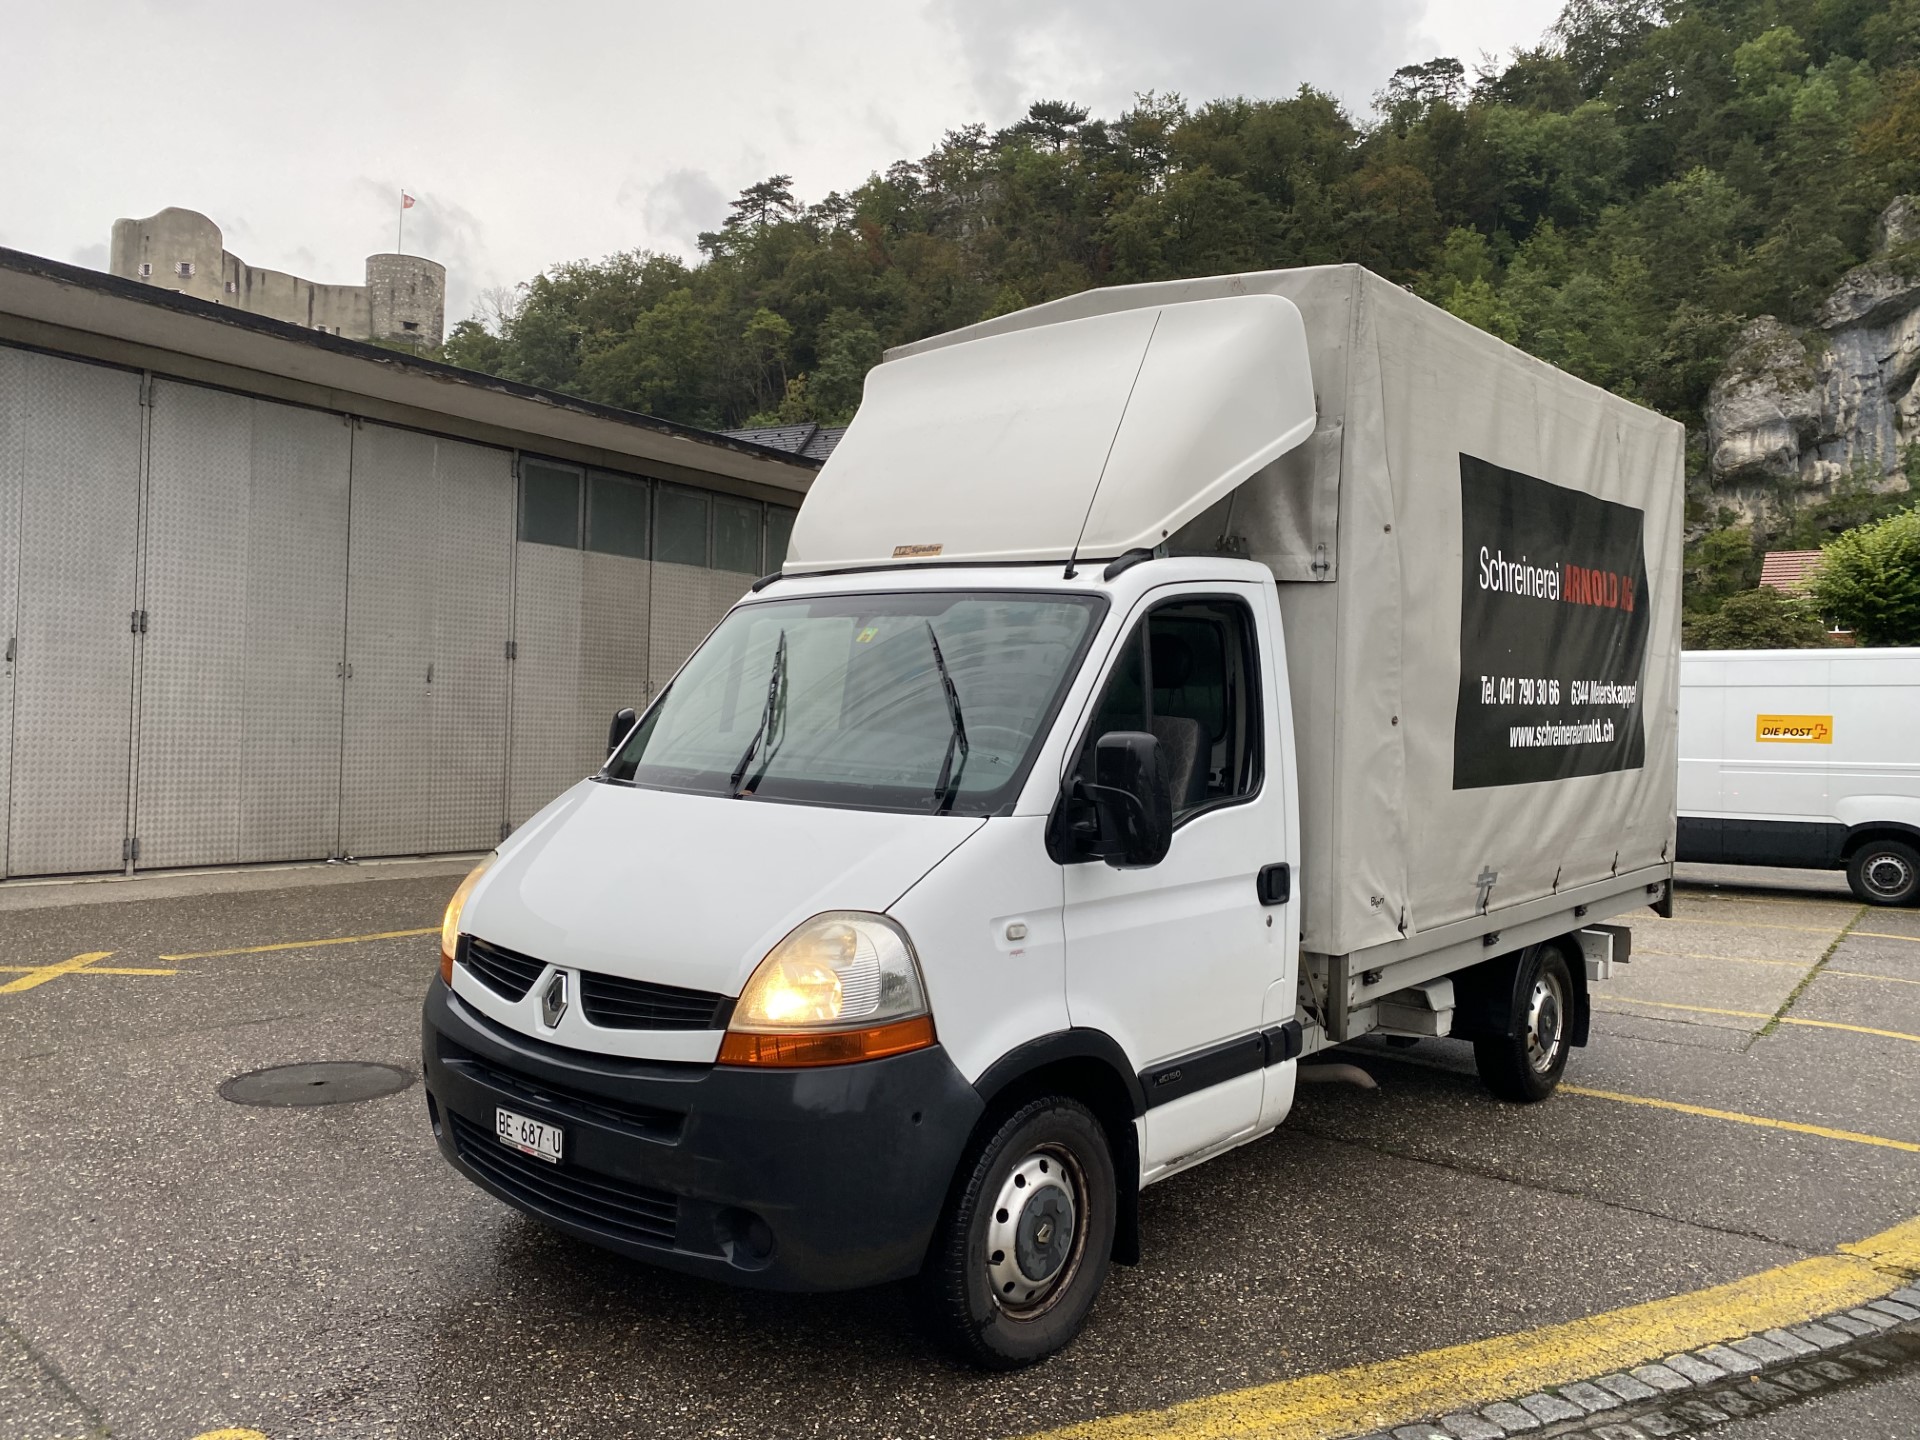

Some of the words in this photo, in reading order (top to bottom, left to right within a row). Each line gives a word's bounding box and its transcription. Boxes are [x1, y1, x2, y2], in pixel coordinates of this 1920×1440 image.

[1480, 546, 1560, 600] Schreinerei
[1563, 564, 1618, 608] ARNOLD
[1620, 575, 1634, 612] AG
[1481, 675, 1497, 705] Tel.
[1499, 677, 1515, 705] 041
[1518, 678, 1535, 706] 790
[1536, 678, 1548, 706] 30
[1549, 679, 1560, 706] 66
[1571, 680, 1589, 706] 6344
[1762, 727, 1781, 736] DIE
[1783, 727, 1813, 737] POST
